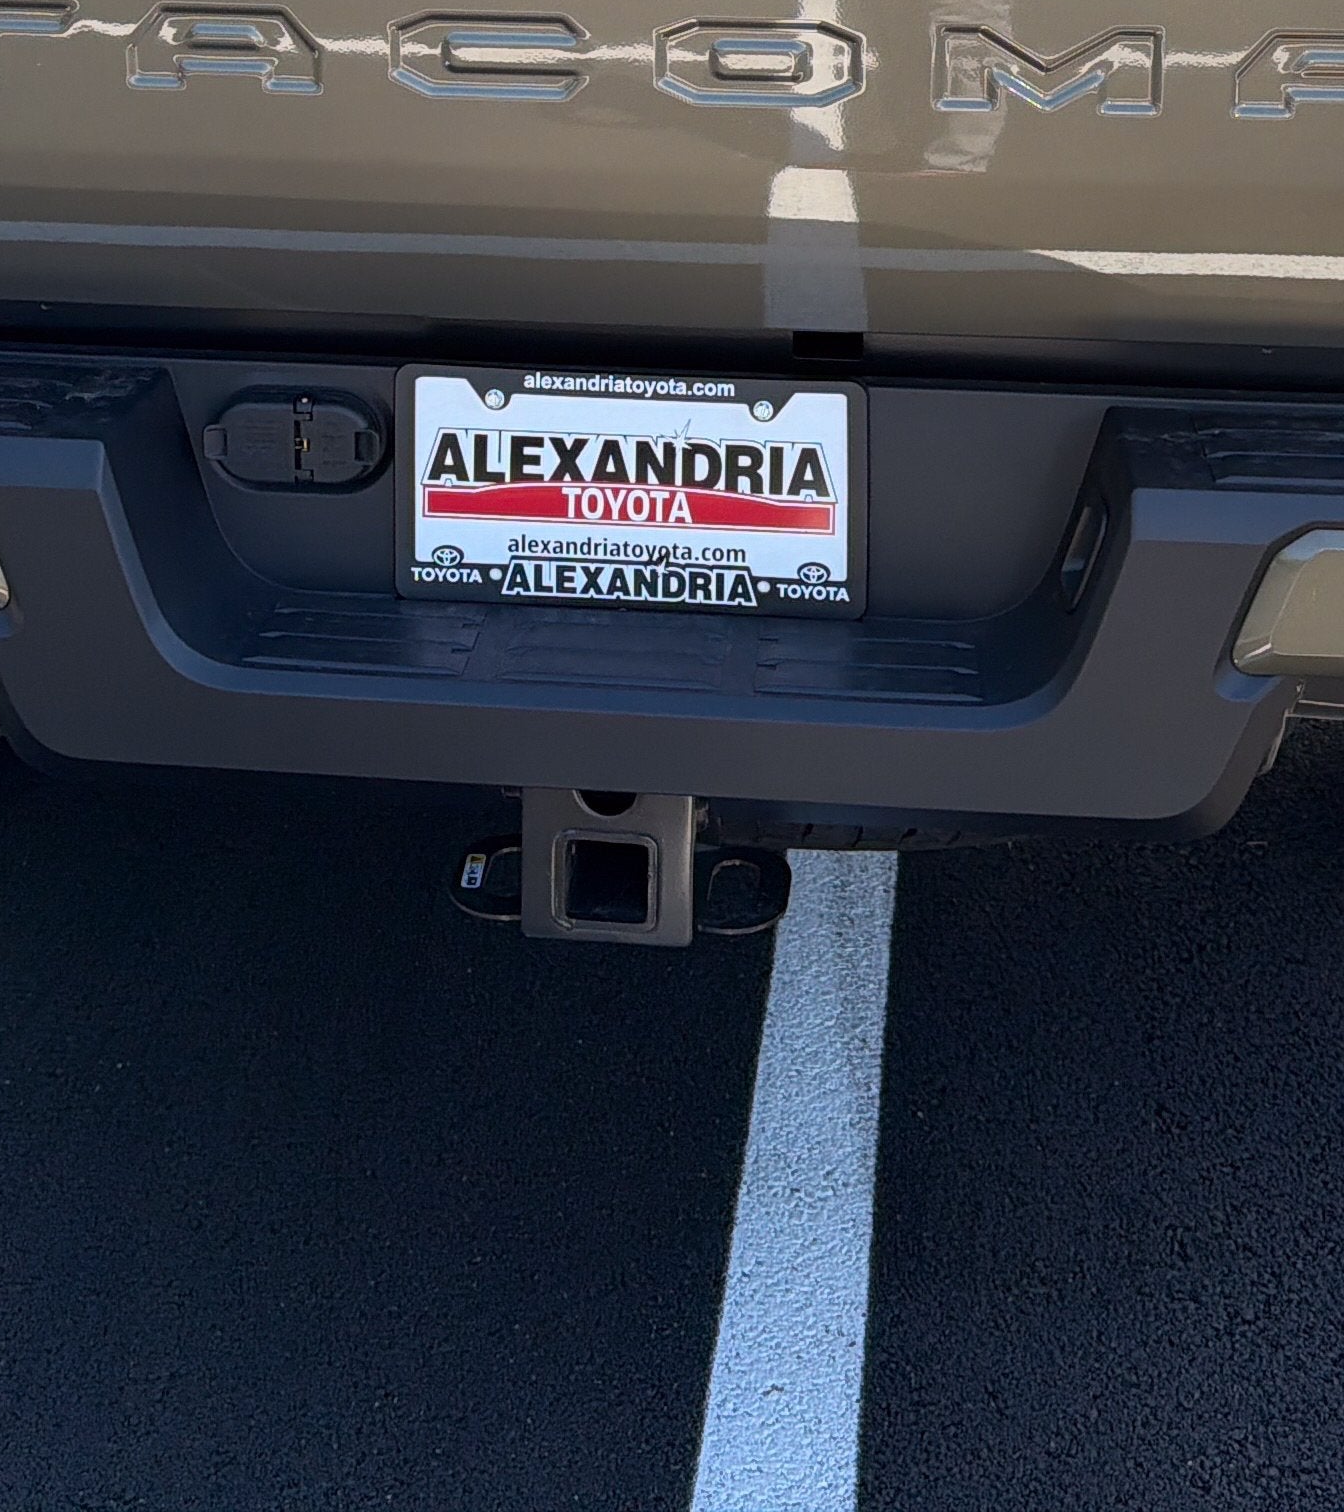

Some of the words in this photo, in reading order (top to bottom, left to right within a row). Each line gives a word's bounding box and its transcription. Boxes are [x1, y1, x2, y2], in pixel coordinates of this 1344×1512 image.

[523, 372, 736, 397] alexandriatoyota.com
[426, 430, 831, 499] ALEXANDRIA
[561, 486, 693, 524] TOYOTA
[507, 533, 747, 563] alexandriatoyota.com
[411, 566, 483, 585] TOYOTA
[502, 561, 757, 606] ALEXANDRIA
[776, 584, 851, 603] TOYOTA
